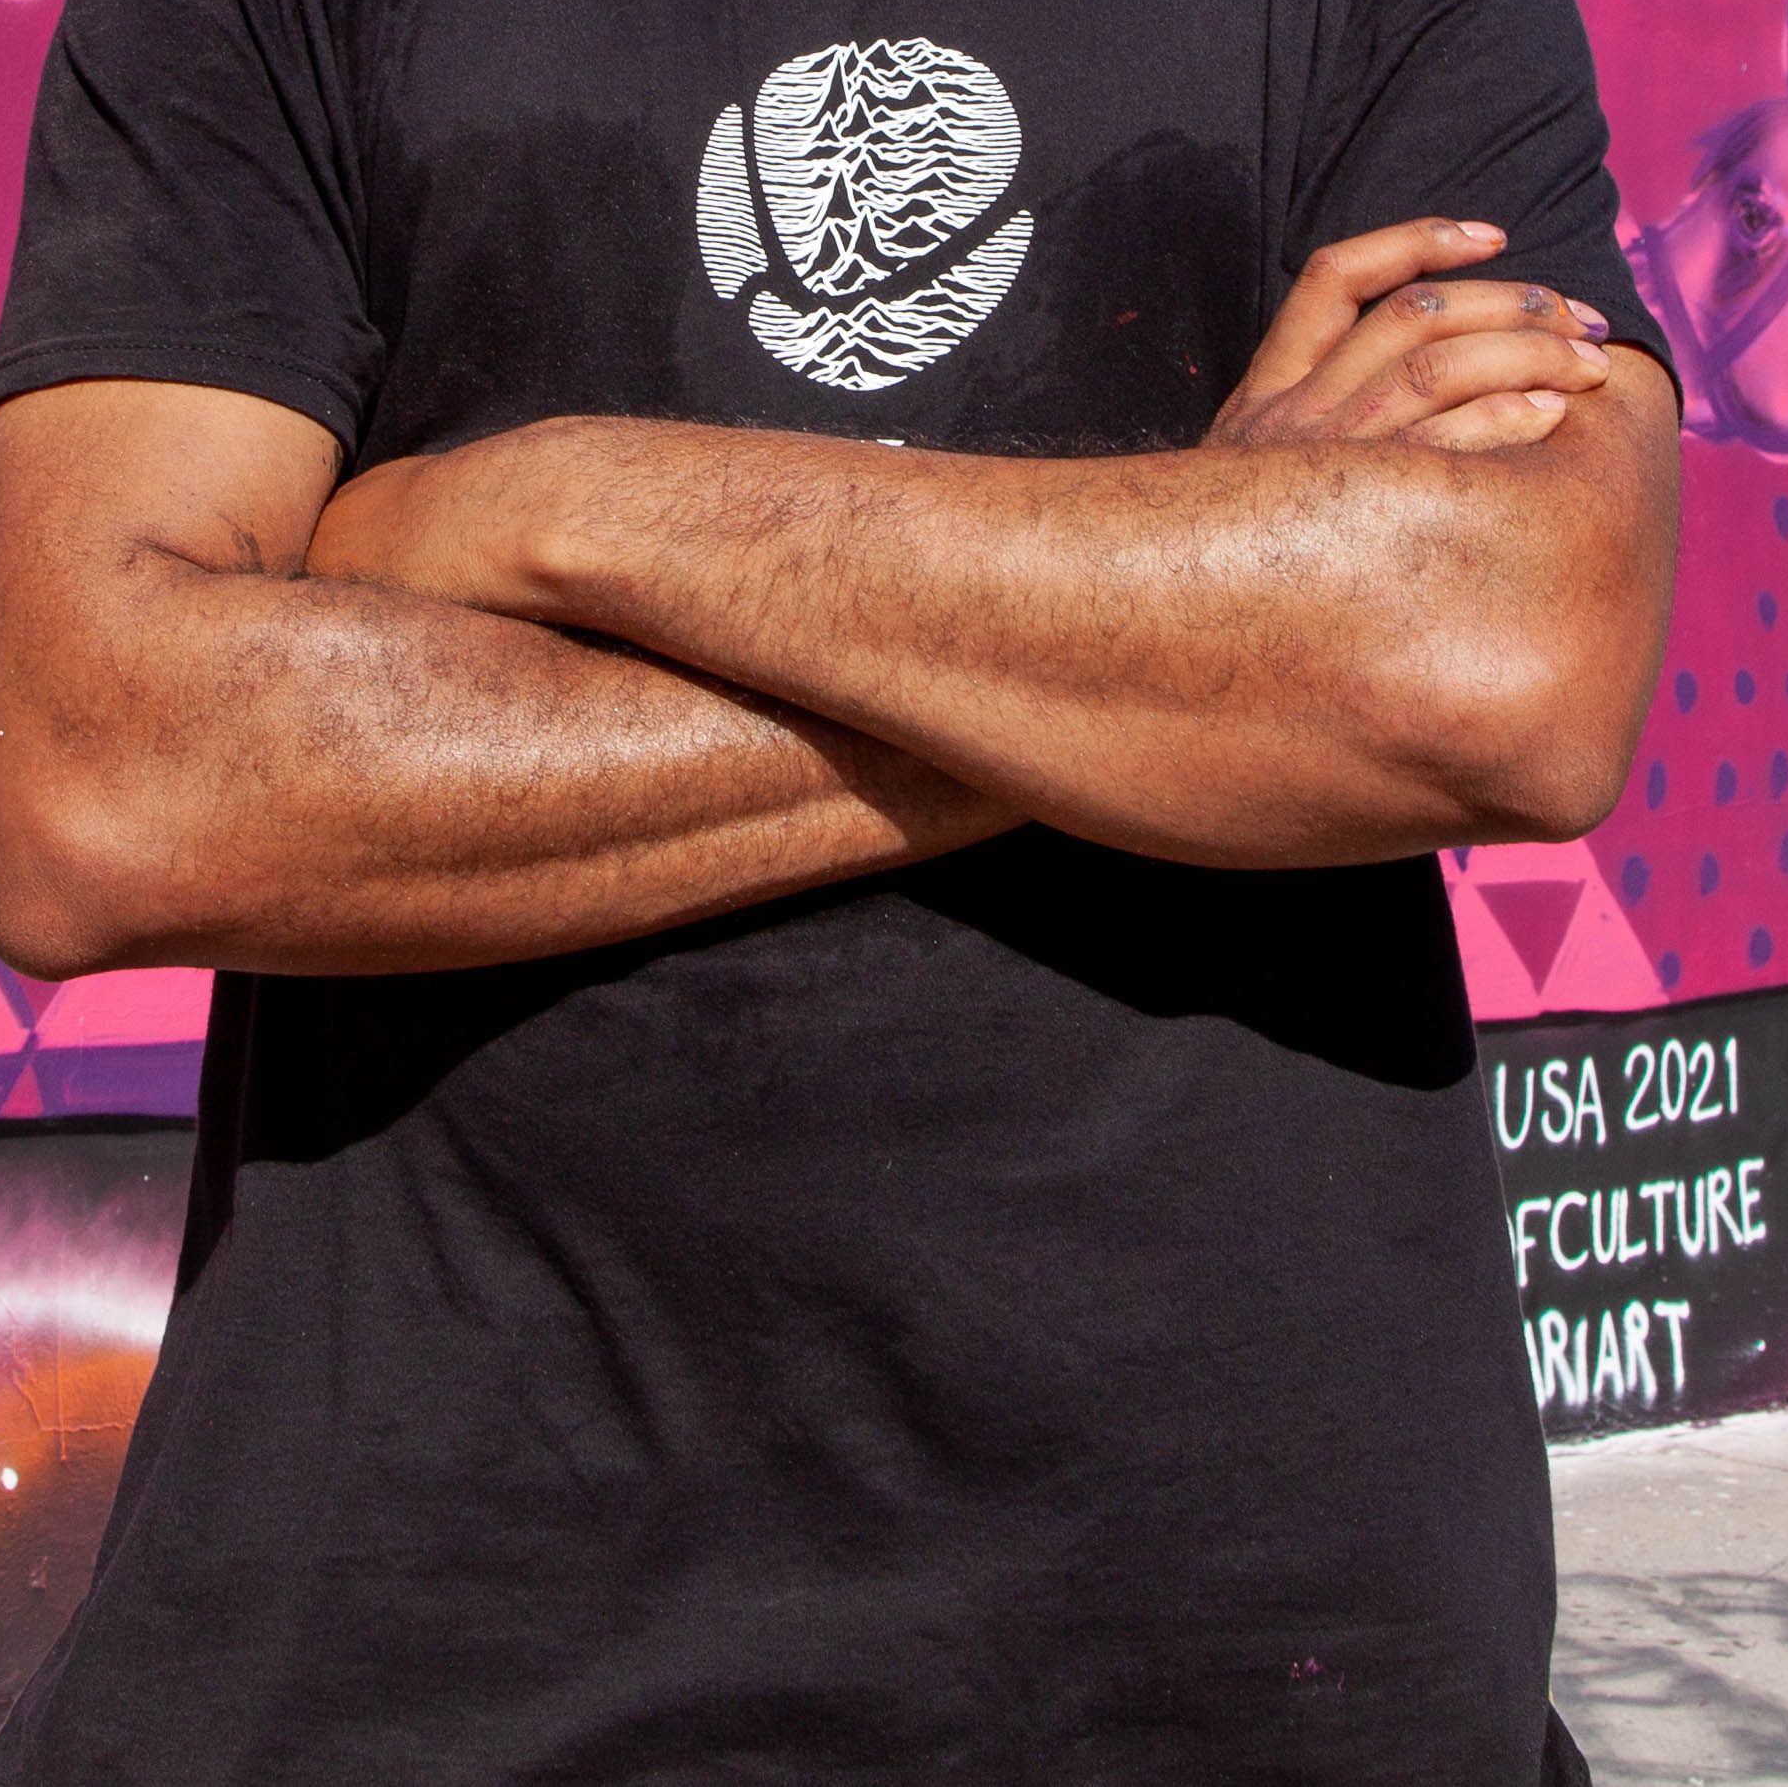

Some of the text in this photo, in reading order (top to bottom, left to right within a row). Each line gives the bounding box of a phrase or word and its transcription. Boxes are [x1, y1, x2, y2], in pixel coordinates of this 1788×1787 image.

[1495, 1036, 1739, 1150] USA 2021
[1507, 1157, 1767, 1288] FCULTURE
